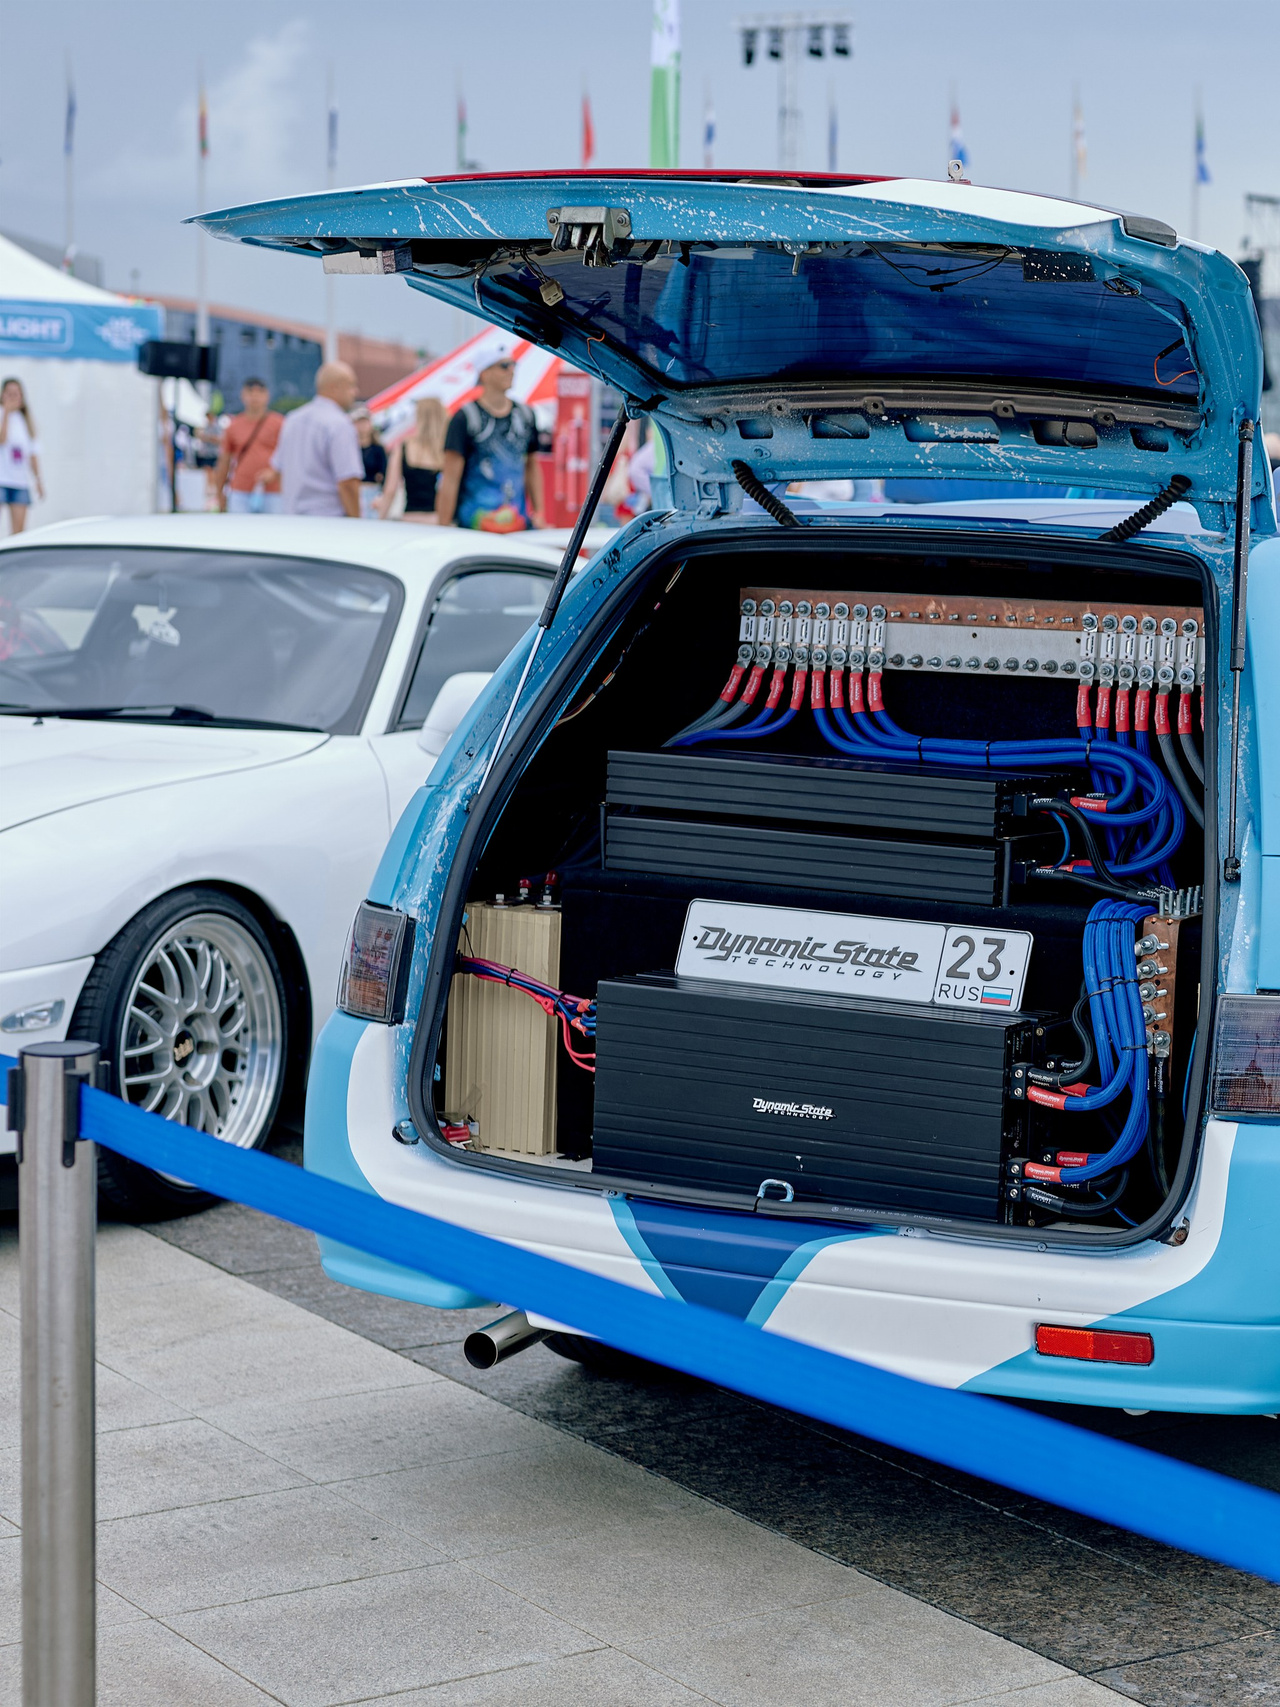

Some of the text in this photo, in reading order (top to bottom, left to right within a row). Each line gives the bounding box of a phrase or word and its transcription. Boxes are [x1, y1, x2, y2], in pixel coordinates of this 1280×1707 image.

[695, 925, 924, 974] Dynamic State
[945, 935, 1006, 982] 23
[731, 955, 902, 981] TECHNOLOGY
[938, 983, 980, 1002] RUS
[752, 1097, 836, 1117] Dynamic State
[768, 1109, 831, 1120] TECHNOLOGY
